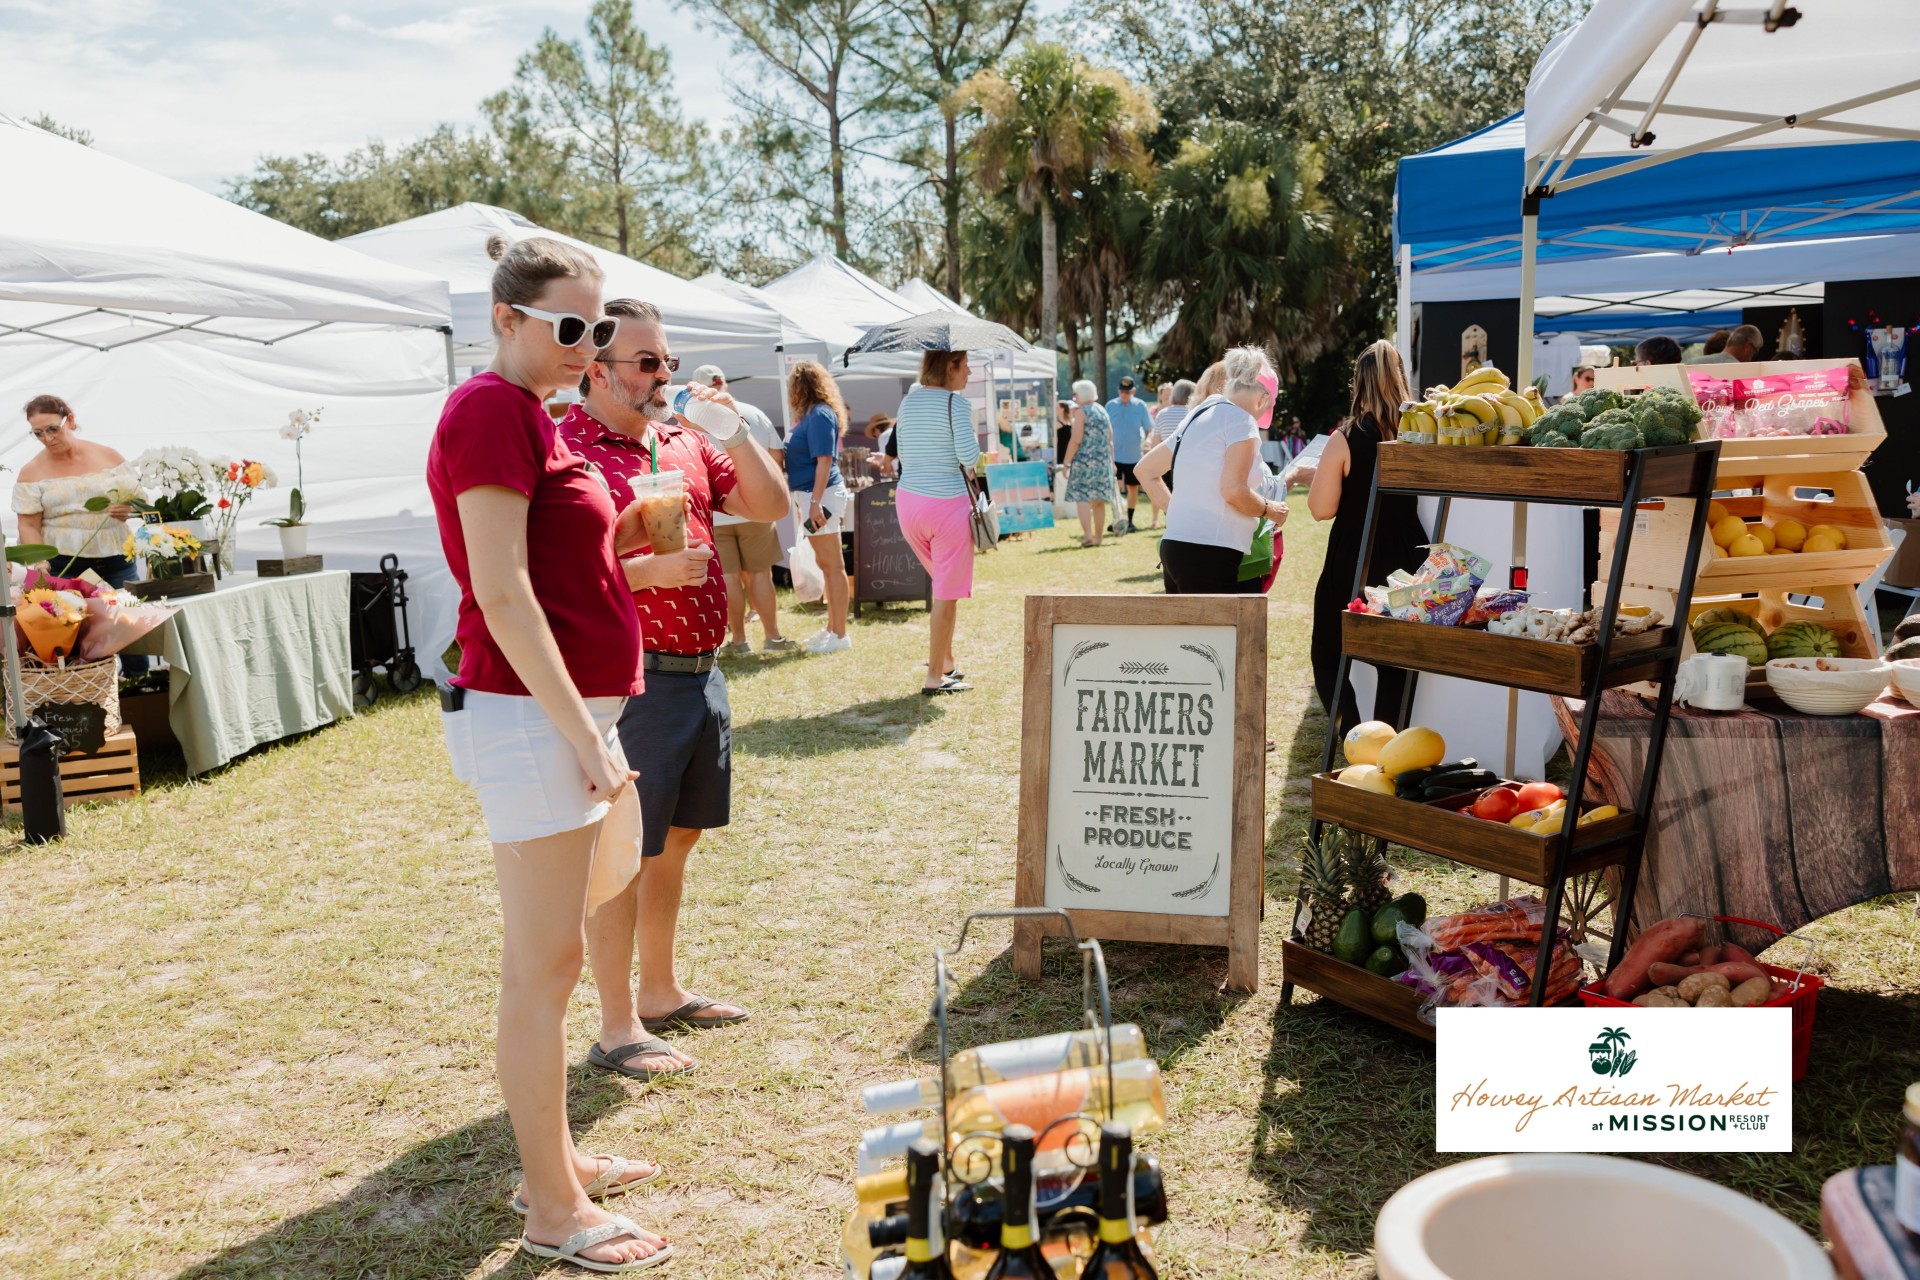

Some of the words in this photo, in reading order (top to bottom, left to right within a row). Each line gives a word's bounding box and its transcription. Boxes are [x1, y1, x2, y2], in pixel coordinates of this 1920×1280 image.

[1744, 398, 1774, 417] Red
[1777, 394, 1829, 417] Grapes
[871, 552, 912, 574] HONEY
[44, 711, 75, 722] Fresh
[1076, 689, 1213, 736] FARMERS
[1083, 740, 1204, 787] MARKET
[1100, 805, 1175, 826] FRESH
[1084, 827, 1192, 850] PRODUCE
[1095, 855, 1136, 875] Locally
[1140, 858, 1179, 874] Grown
